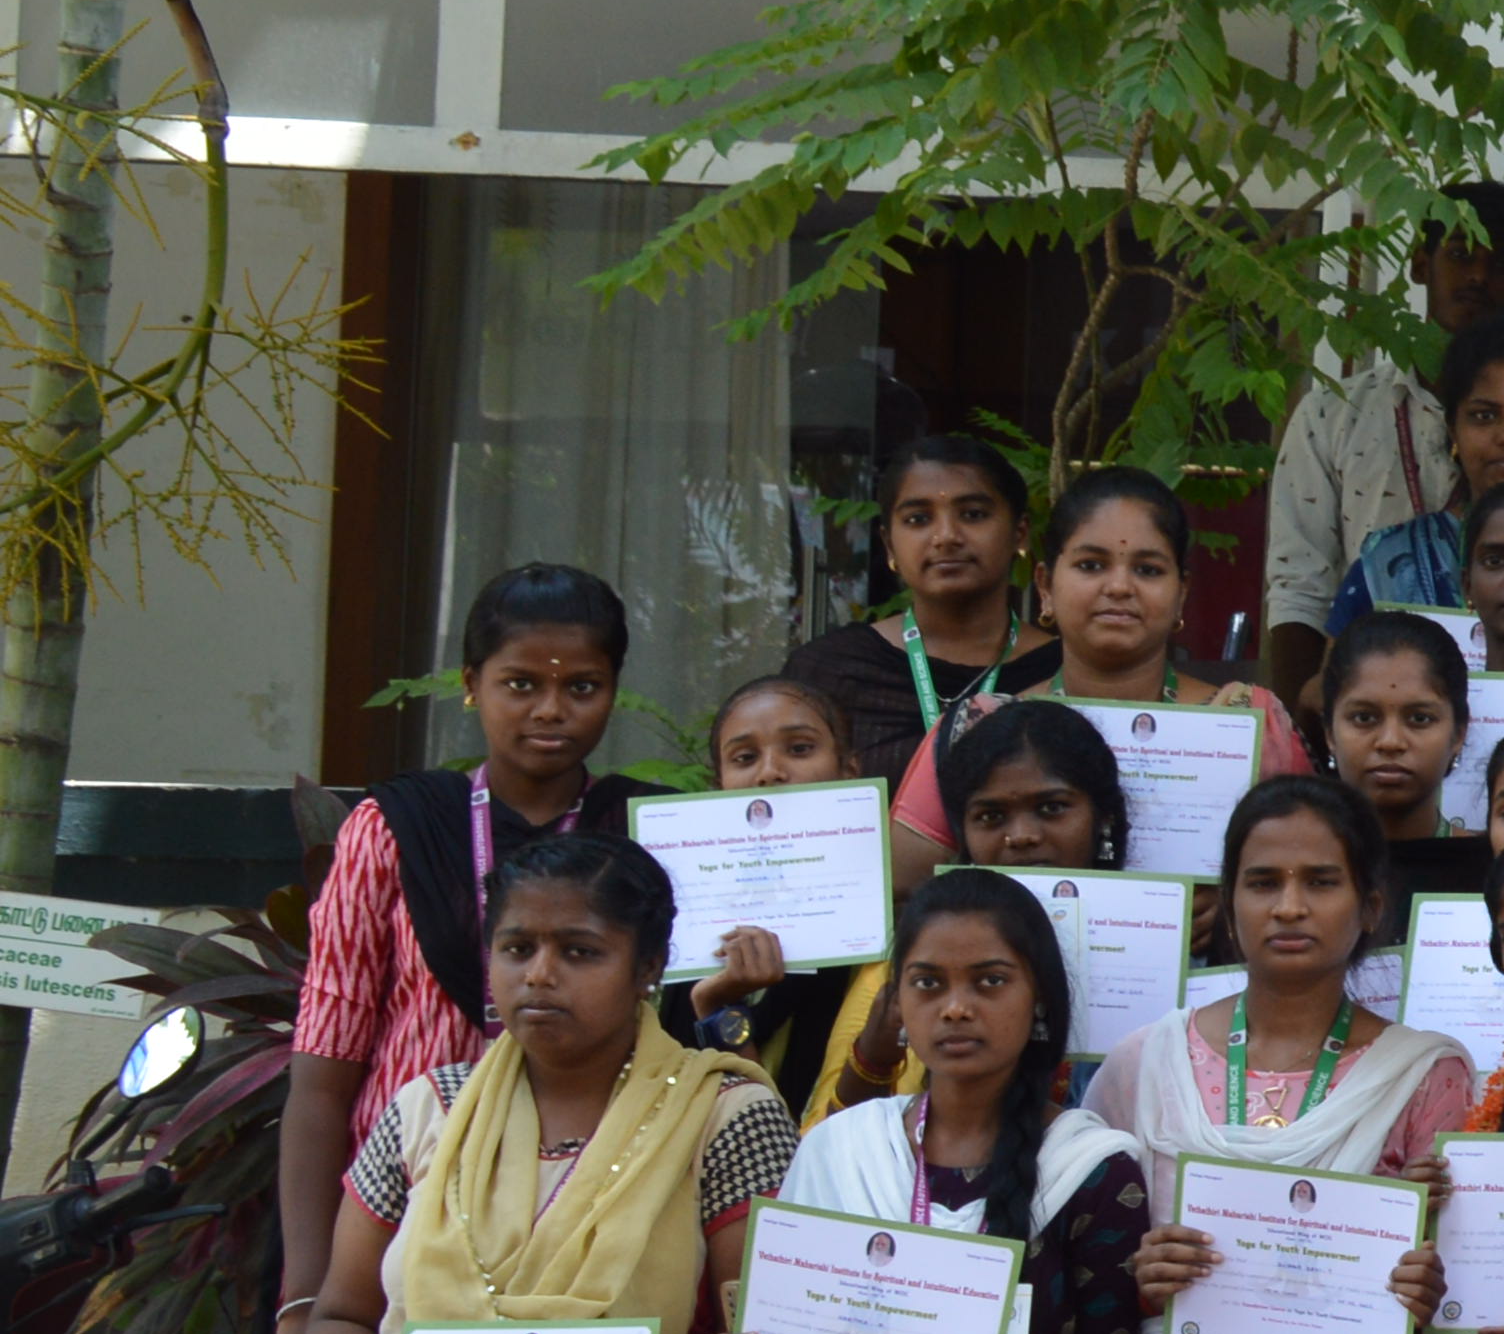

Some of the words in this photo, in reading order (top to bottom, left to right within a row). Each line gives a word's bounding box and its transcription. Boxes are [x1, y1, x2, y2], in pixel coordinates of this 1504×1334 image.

[24, 974, 117, 1002] lutescens
[1229, 1064, 1239, 1105] SCIENCE
[1237, 1239, 1256, 1250] Yoga
[1260, 1242, 1271, 1251] for
[1276, 1244, 1298, 1254] Youth
[1303, 1248, 1360, 1262] Empowerment
[806, 1290, 827, 1303] Yoga
[831, 1294, 843, 1304] for
[848, 1297, 872, 1309] Youth
[877, 1302, 938, 1320] Empowerment
